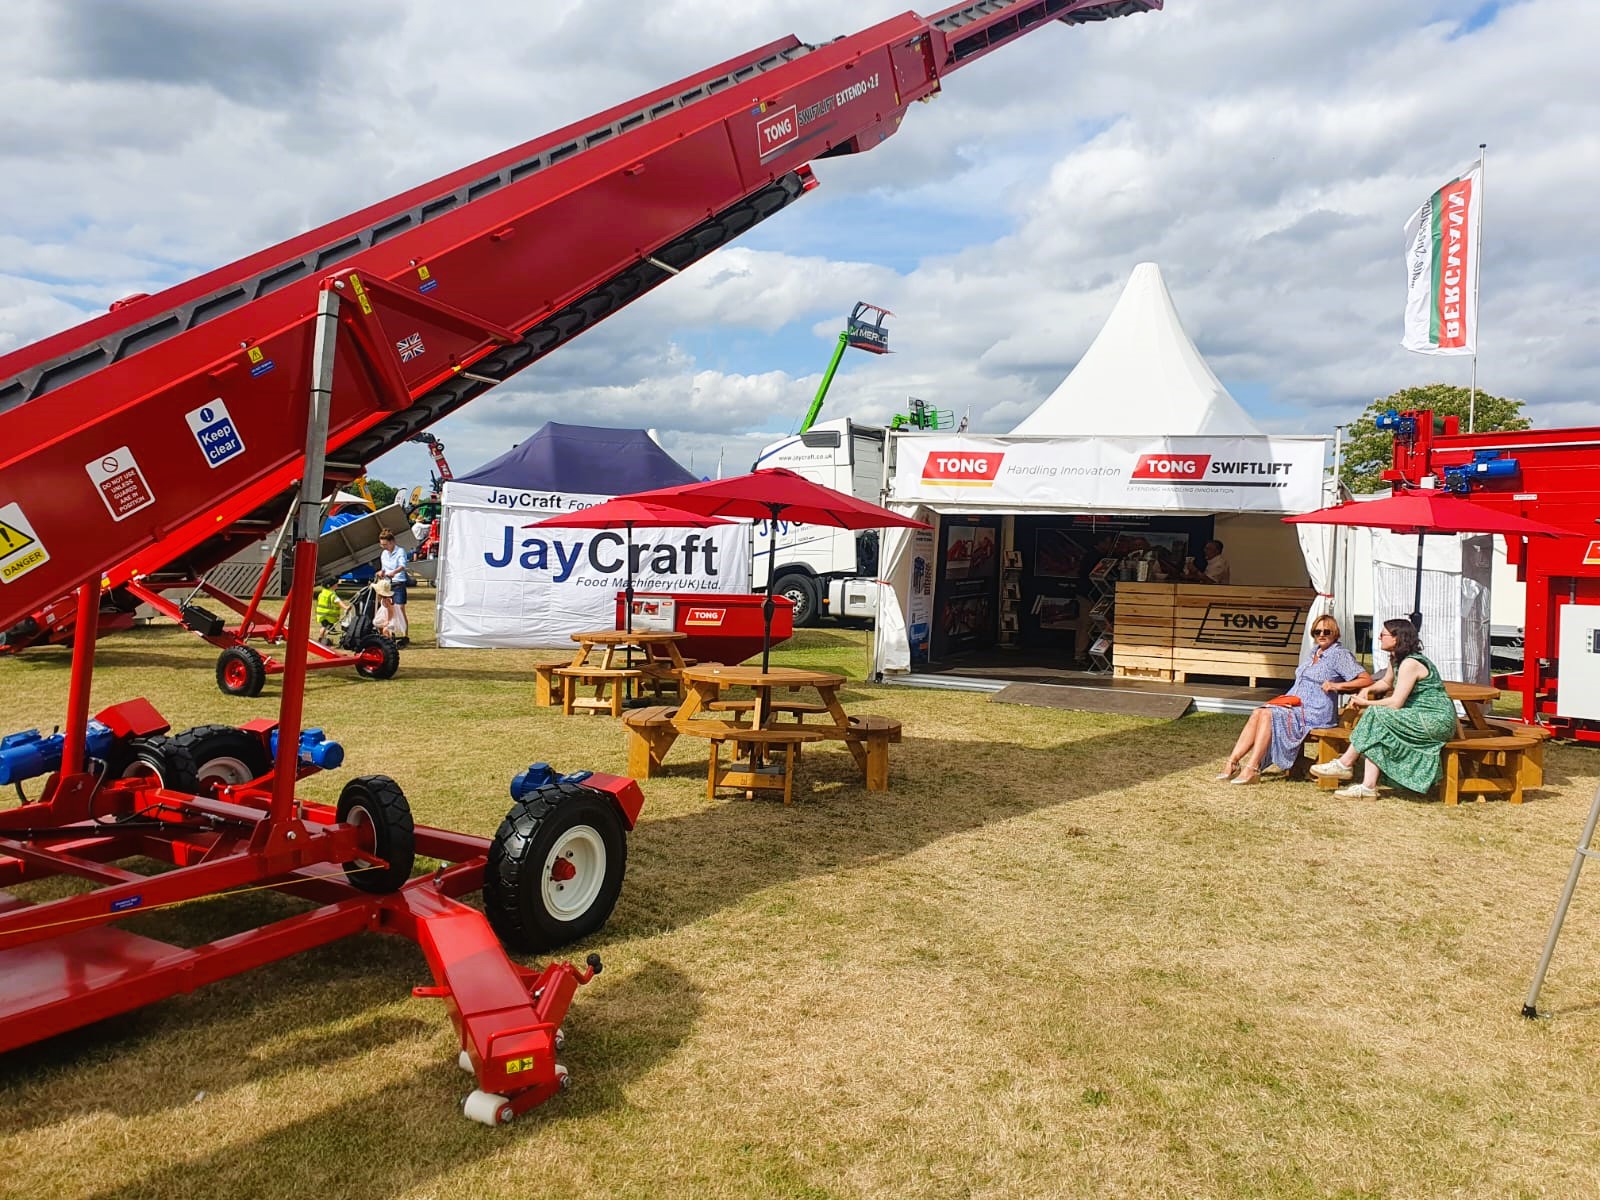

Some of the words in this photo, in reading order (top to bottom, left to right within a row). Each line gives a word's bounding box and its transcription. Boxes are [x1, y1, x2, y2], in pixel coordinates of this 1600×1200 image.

[764, 118, 792, 143] TONG
[797, 95, 836, 126] SWIFTLIFT
[836, 79, 867, 106] EXTENDO
[201, 425, 230, 446] Keep
[210, 439, 236, 459] clear
[937, 458, 987, 473] TONG
[1007, 465, 1057, 477] Handling
[1060, 466, 1121, 477] Innovation
[1147, 460, 1196, 474] TONG
[1211, 462, 1293, 475] SWIFTLIFT
[102, 482, 111, 490] DO
[111, 475, 123, 485] NOT
[123, 469, 136, 479] USE
[111, 478, 134, 493] UNLESS
[113, 485, 137, 499] GUARDS
[120, 494, 132, 504] ARE
[488, 490, 562, 508] JayCraft
[568, 500, 602, 510] Foo
[119, 495, 145, 512] POSITION
[484, 526, 719, 583] JayCraft
[3, 551, 43, 577] DANGER
[576, 577, 608, 587] Food
[694, 611, 718, 619] TONG
[1220, 612, 1280, 630] TONG
